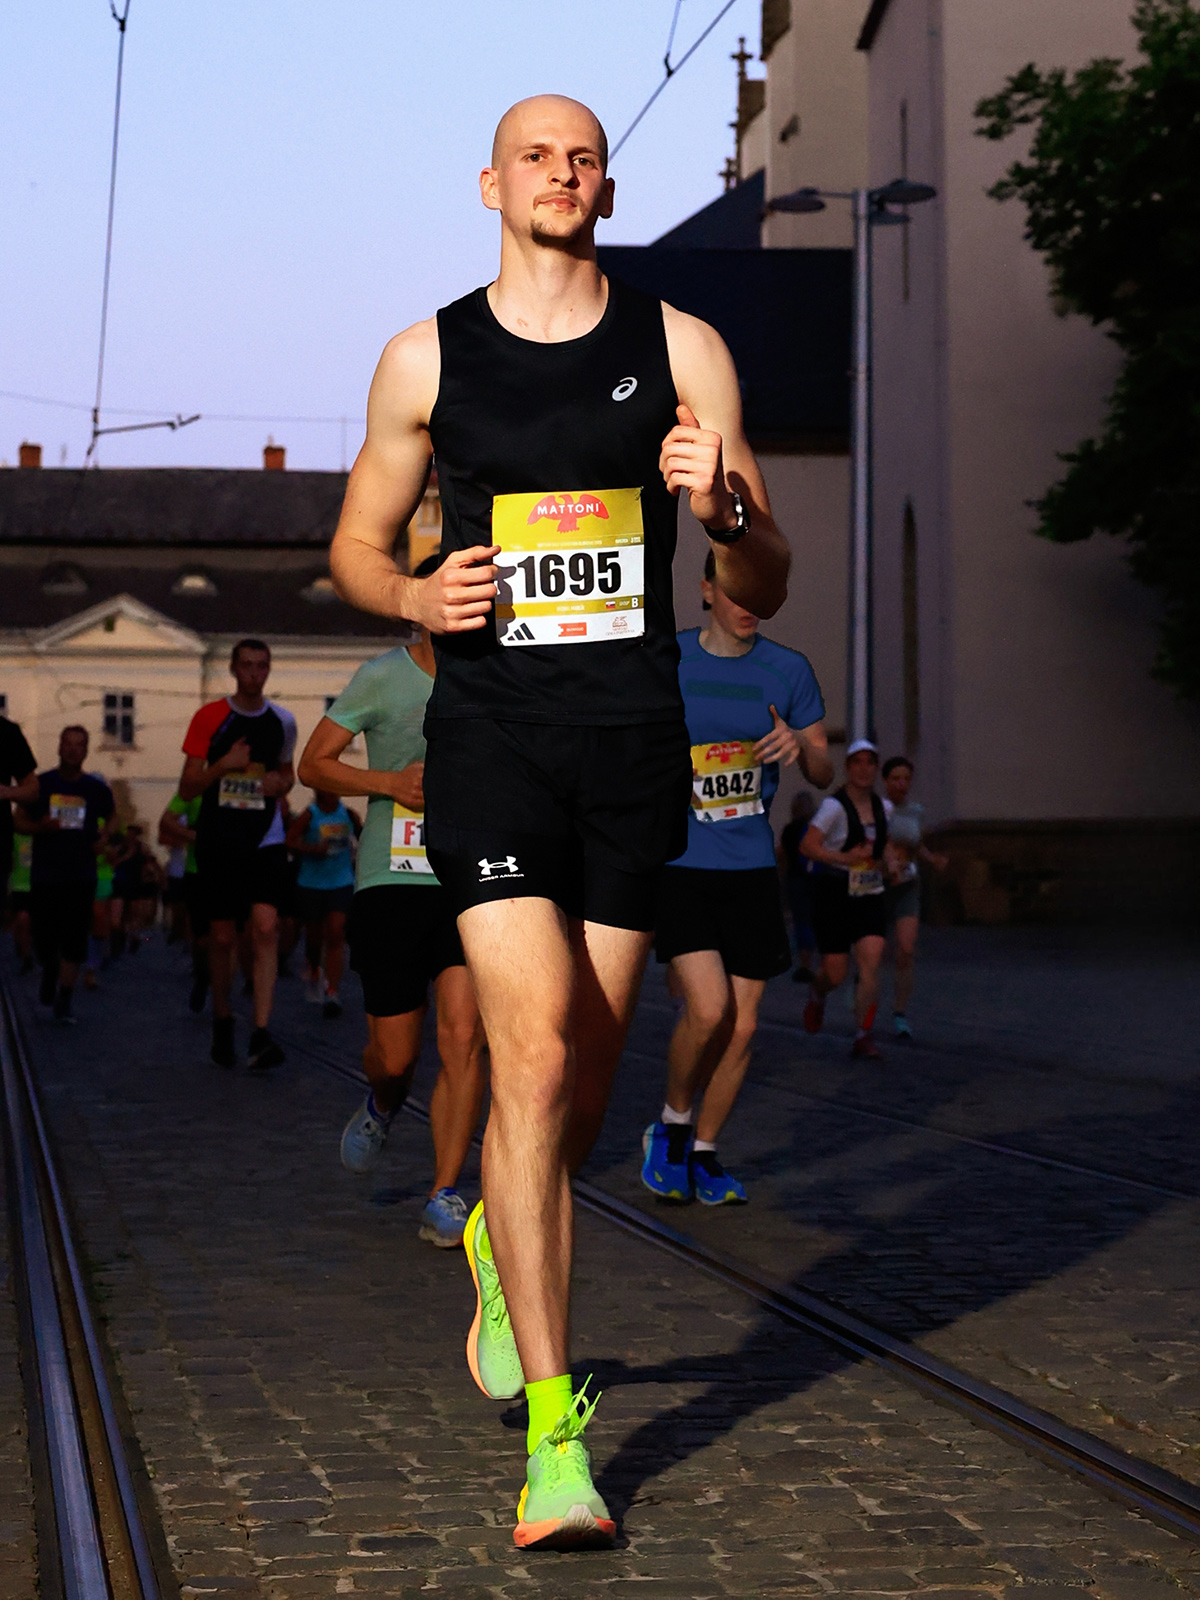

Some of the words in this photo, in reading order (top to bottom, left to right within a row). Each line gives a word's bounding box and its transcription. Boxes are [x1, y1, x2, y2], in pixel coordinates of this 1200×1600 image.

[537, 503, 600, 515] MATTONI
[517, 551, 622, 598] 1695
[631, 597, 639, 608] B
[702, 771, 753, 798] 4842
